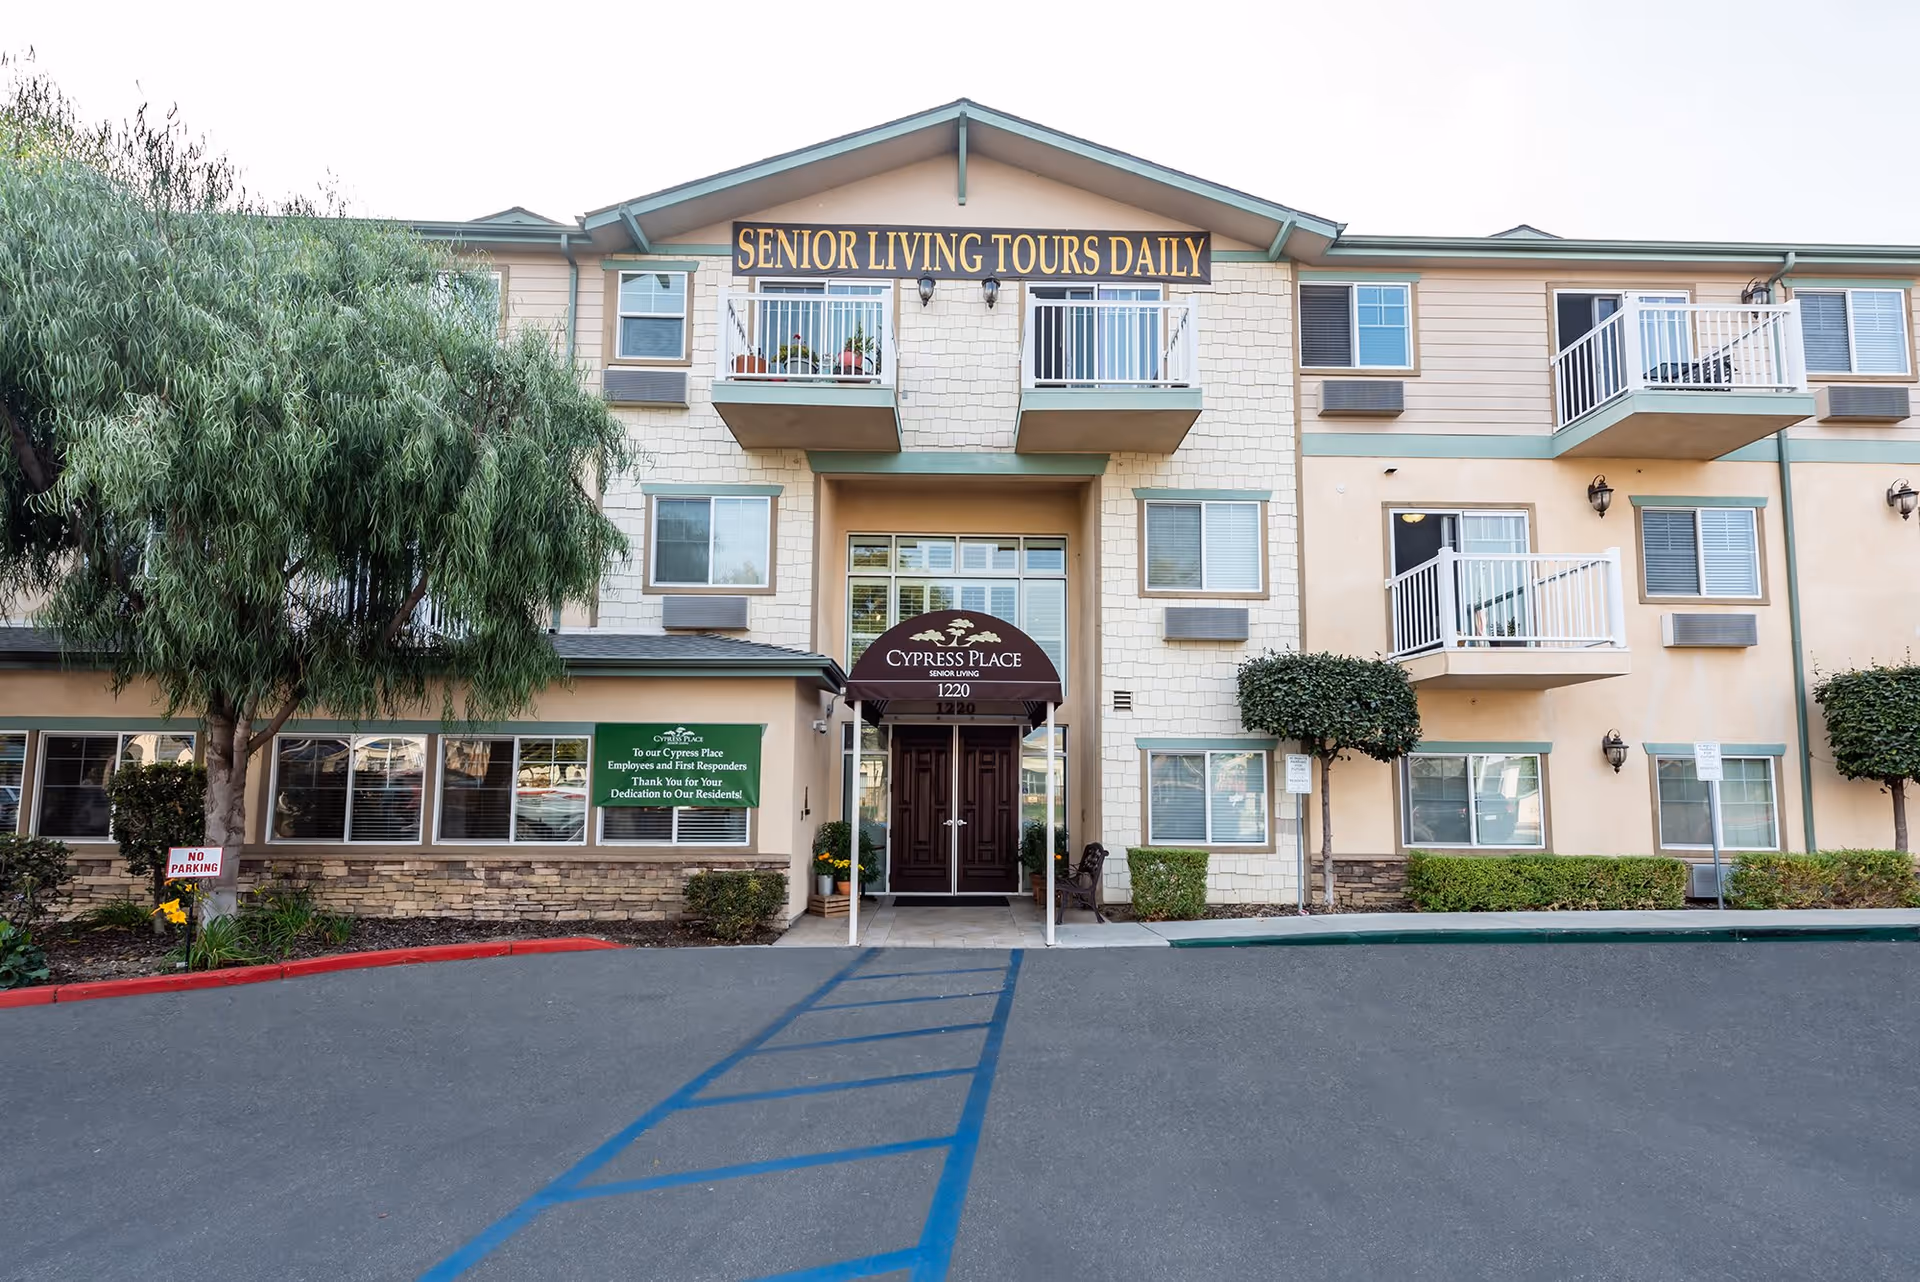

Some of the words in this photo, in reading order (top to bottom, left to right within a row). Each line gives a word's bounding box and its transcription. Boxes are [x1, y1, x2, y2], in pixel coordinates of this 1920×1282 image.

[737, 227, 859, 270] SENIOR
[867, 231, 983, 273] LIVING
[992, 233, 1100, 276] TOURS
[1108, 235, 1206, 278] DAILY
[886, 650, 964, 667] CYPRESS
[969, 650, 1022, 668] PLACE
[929, 669, 955, 677] SENIOR
[937, 683, 970, 698] 1220
[936, 702, 976, 714] 1220
[632, 748, 644, 757] To
[662, 748, 699, 760] Cypress
[701, 748, 724, 758] Place
[607, 761, 655, 772] Employees
[656, 761, 673, 770] and
[675, 761, 695, 770] First
[697, 761, 747, 773] Responders
[631, 777, 663, 786] Thank
[665, 777, 683, 786] You
[684, 777, 698, 786] for
[700, 777, 723, 786] Your
[610, 789, 661, 799] Dedication
[663, 790, 672, 799] to
[674, 789, 694, 799] Our
[695, 789, 743, 800] Residents!
[188, 852, 204, 861] NO
[171, 863, 218, 873] PARKING
